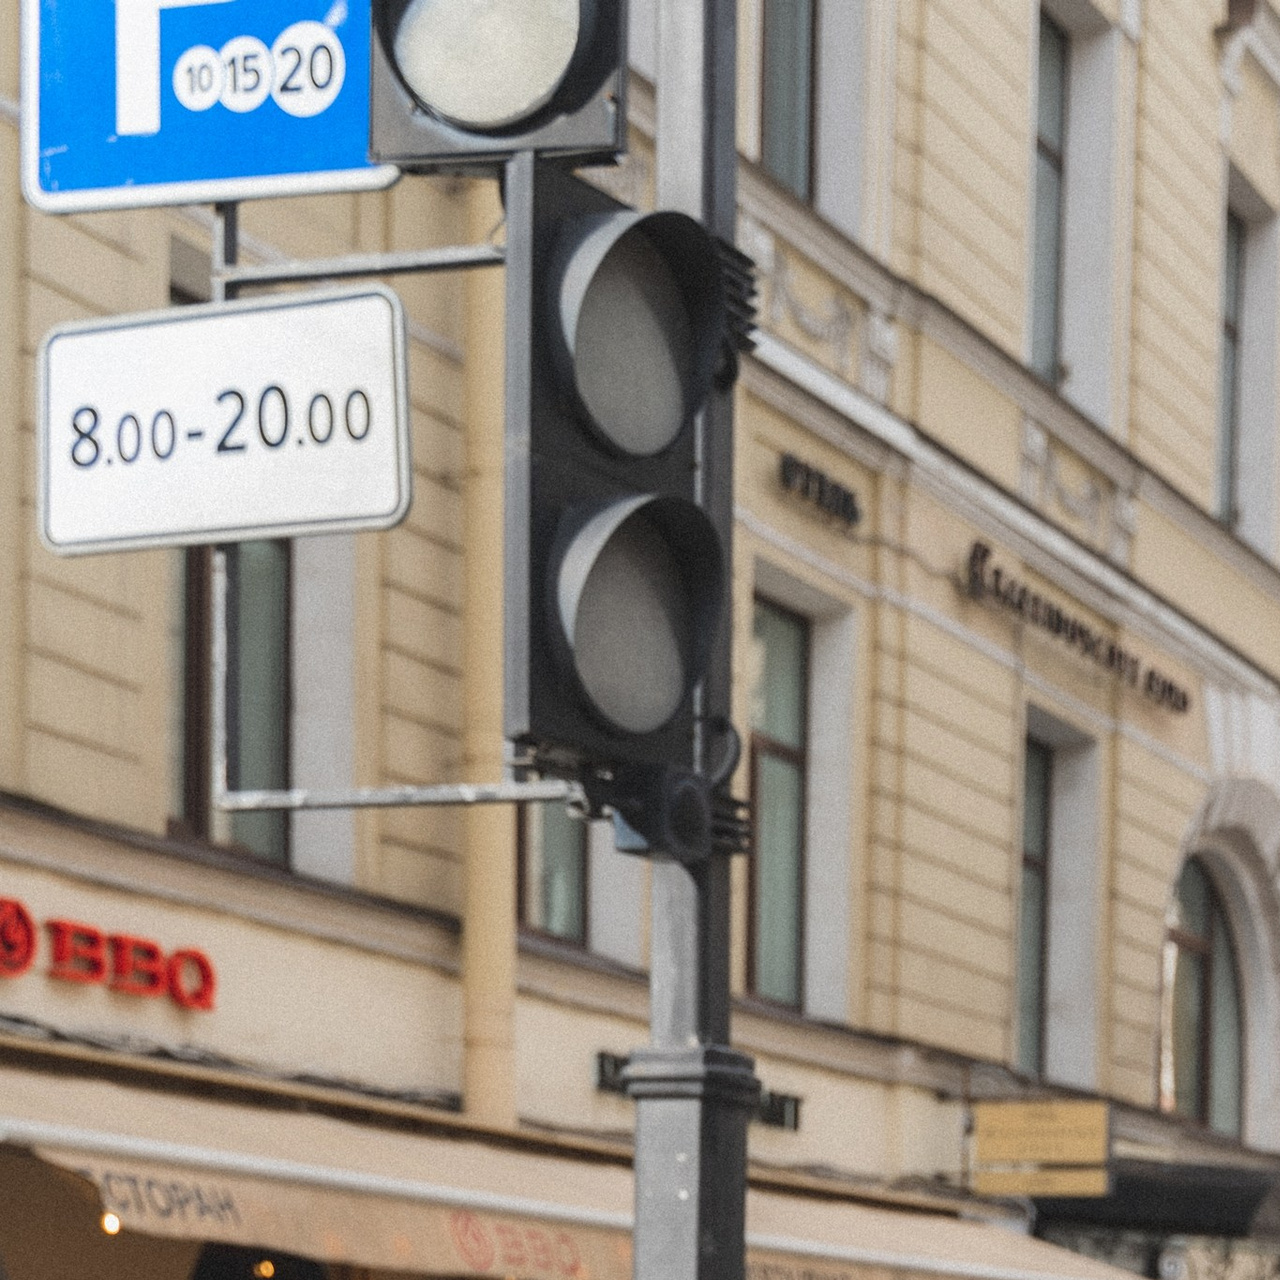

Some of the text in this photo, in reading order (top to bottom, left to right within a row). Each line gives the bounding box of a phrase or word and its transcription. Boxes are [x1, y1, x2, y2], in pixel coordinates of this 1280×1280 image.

[186, 44, 333, 94] 10 15 20
[70, 385, 371, 468] 8.00-20.00
[45, 918, 217, 1011] BBQ
[82, 1167, 241, 1226] СТОРАН
